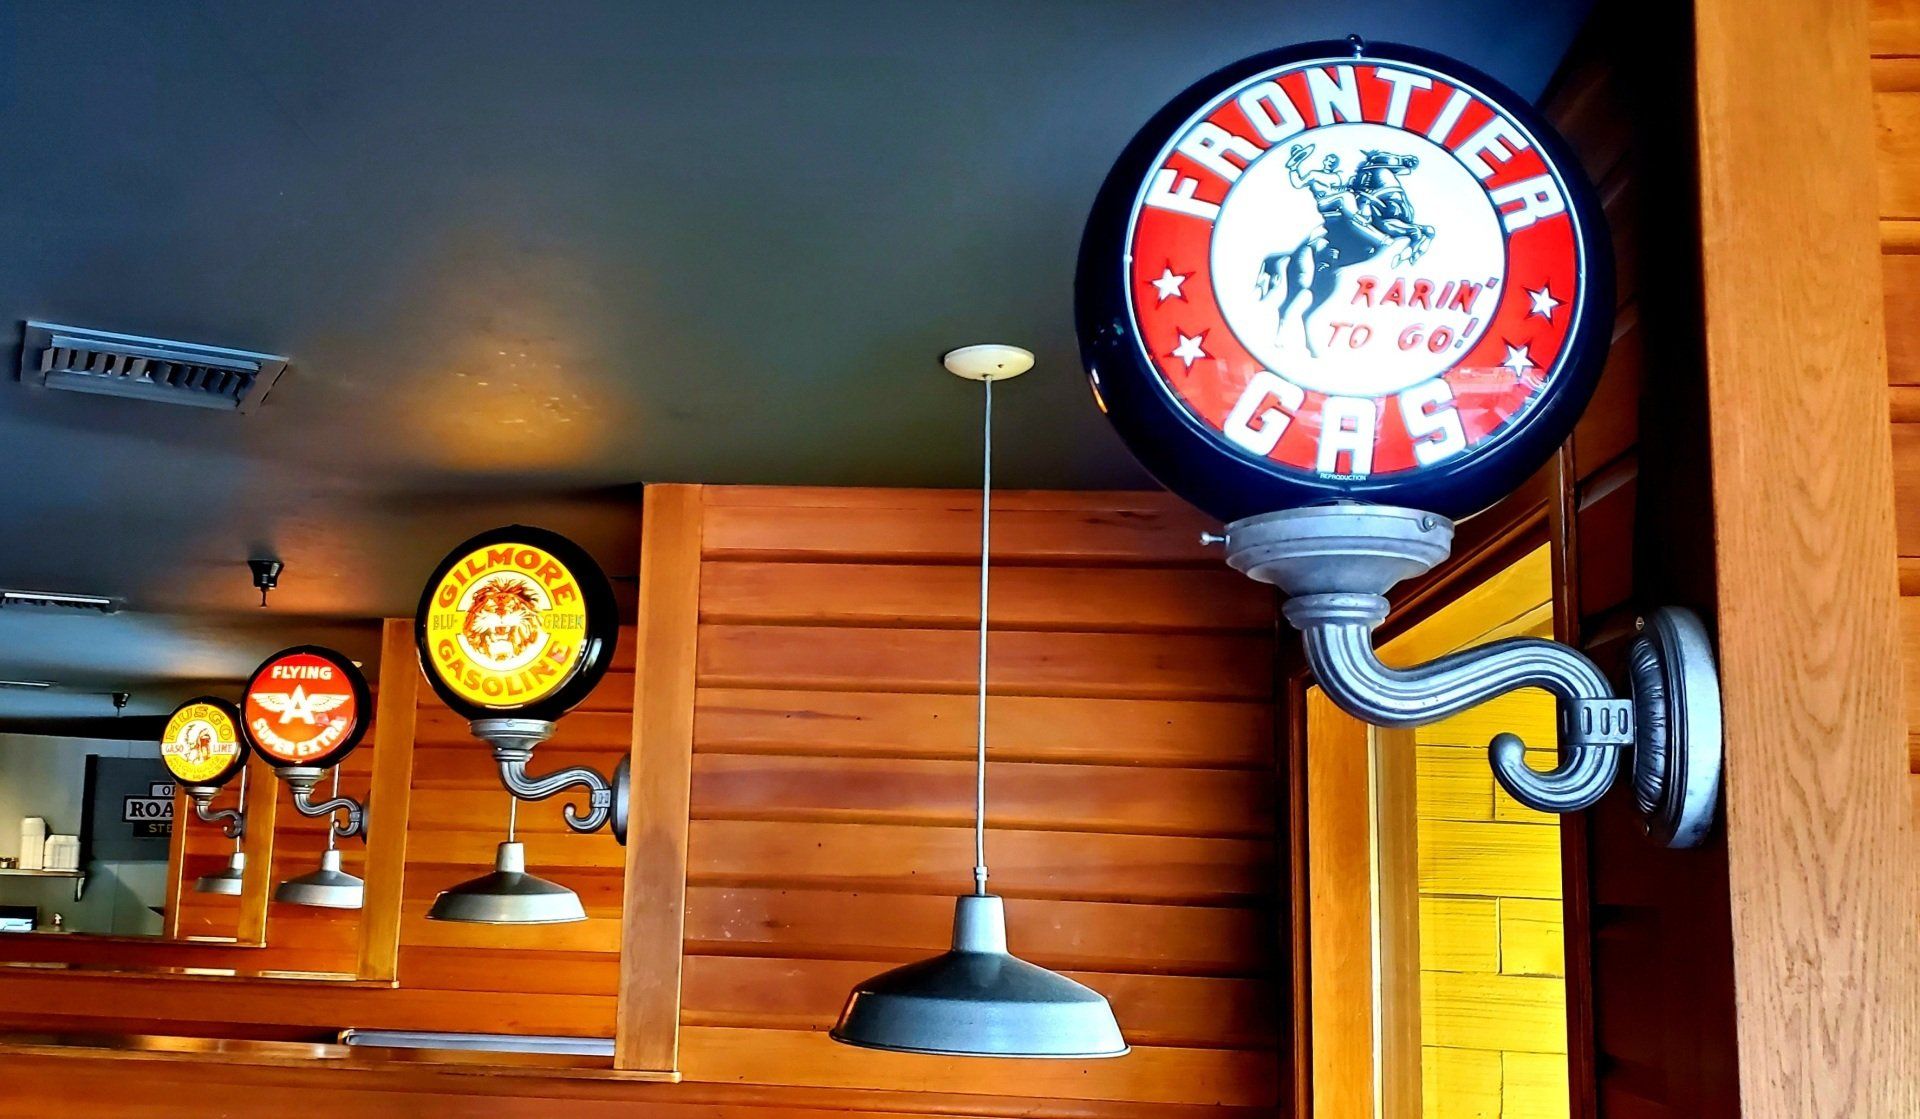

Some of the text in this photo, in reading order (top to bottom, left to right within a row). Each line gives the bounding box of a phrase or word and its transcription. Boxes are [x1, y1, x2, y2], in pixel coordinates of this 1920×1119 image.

[1144, 65, 1566, 234] FRONTIER
[1350, 274, 1500, 311] RARIN'
[1327, 318, 1479, 355] TO GO!
[1222, 371, 1469, 476] GAS
[1319, 472, 1367, 481] REPRODUCTION
[438, 547, 577, 609] GILMORE
[271, 665, 332, 681] FLYING
[438, 639, 571, 697] GASOLINE
[166, 706, 232, 741] MUSGO
[252, 716, 348, 756] SUPER EXTRA
